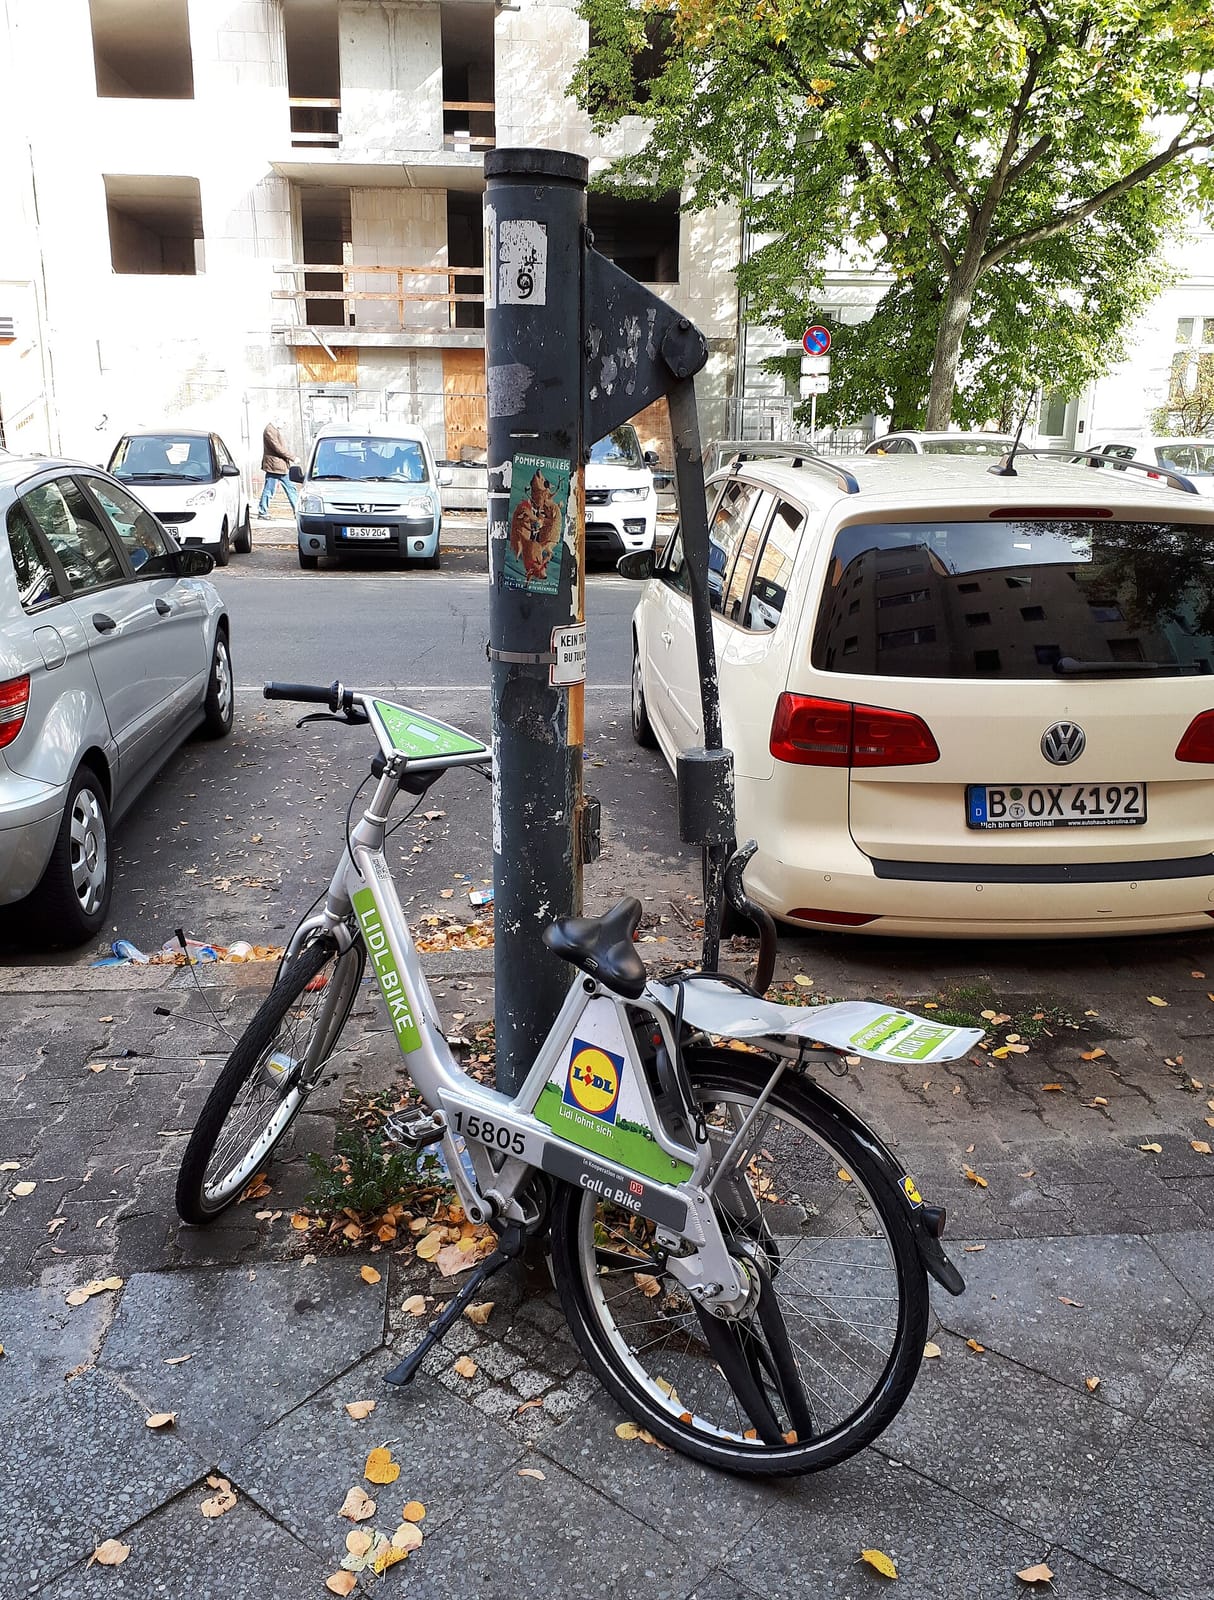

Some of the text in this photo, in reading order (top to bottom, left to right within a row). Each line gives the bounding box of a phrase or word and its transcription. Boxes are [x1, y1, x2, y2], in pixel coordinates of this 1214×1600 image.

[514, 455, 545, 468] POMMES
[350, 528, 387, 536] B SV 204
[560, 635, 578, 647] KEIN
[564, 652, 573, 663] BU
[989, 790, 1007, 818] B
[1028, 788, 1064, 817] OX
[1071, 786, 1140, 815] 4192
[998, 820, 1010, 828] bin
[1011, 820, 1022, 828] ein
[1023, 819, 1055, 827] Berolina!
[360, 908, 414, 1034] LIDL-BIKE
[573, 1065, 614, 1095] LIDL
[560, 1106, 614, 1139] Lidl lohnt sich.
[454, 1111, 526, 1155] 15805
[589, 1160, 616, 1178] Kooperation
[580, 1173, 642, 1212] Call a Bike
[630, 1181, 644, 1195] DB
